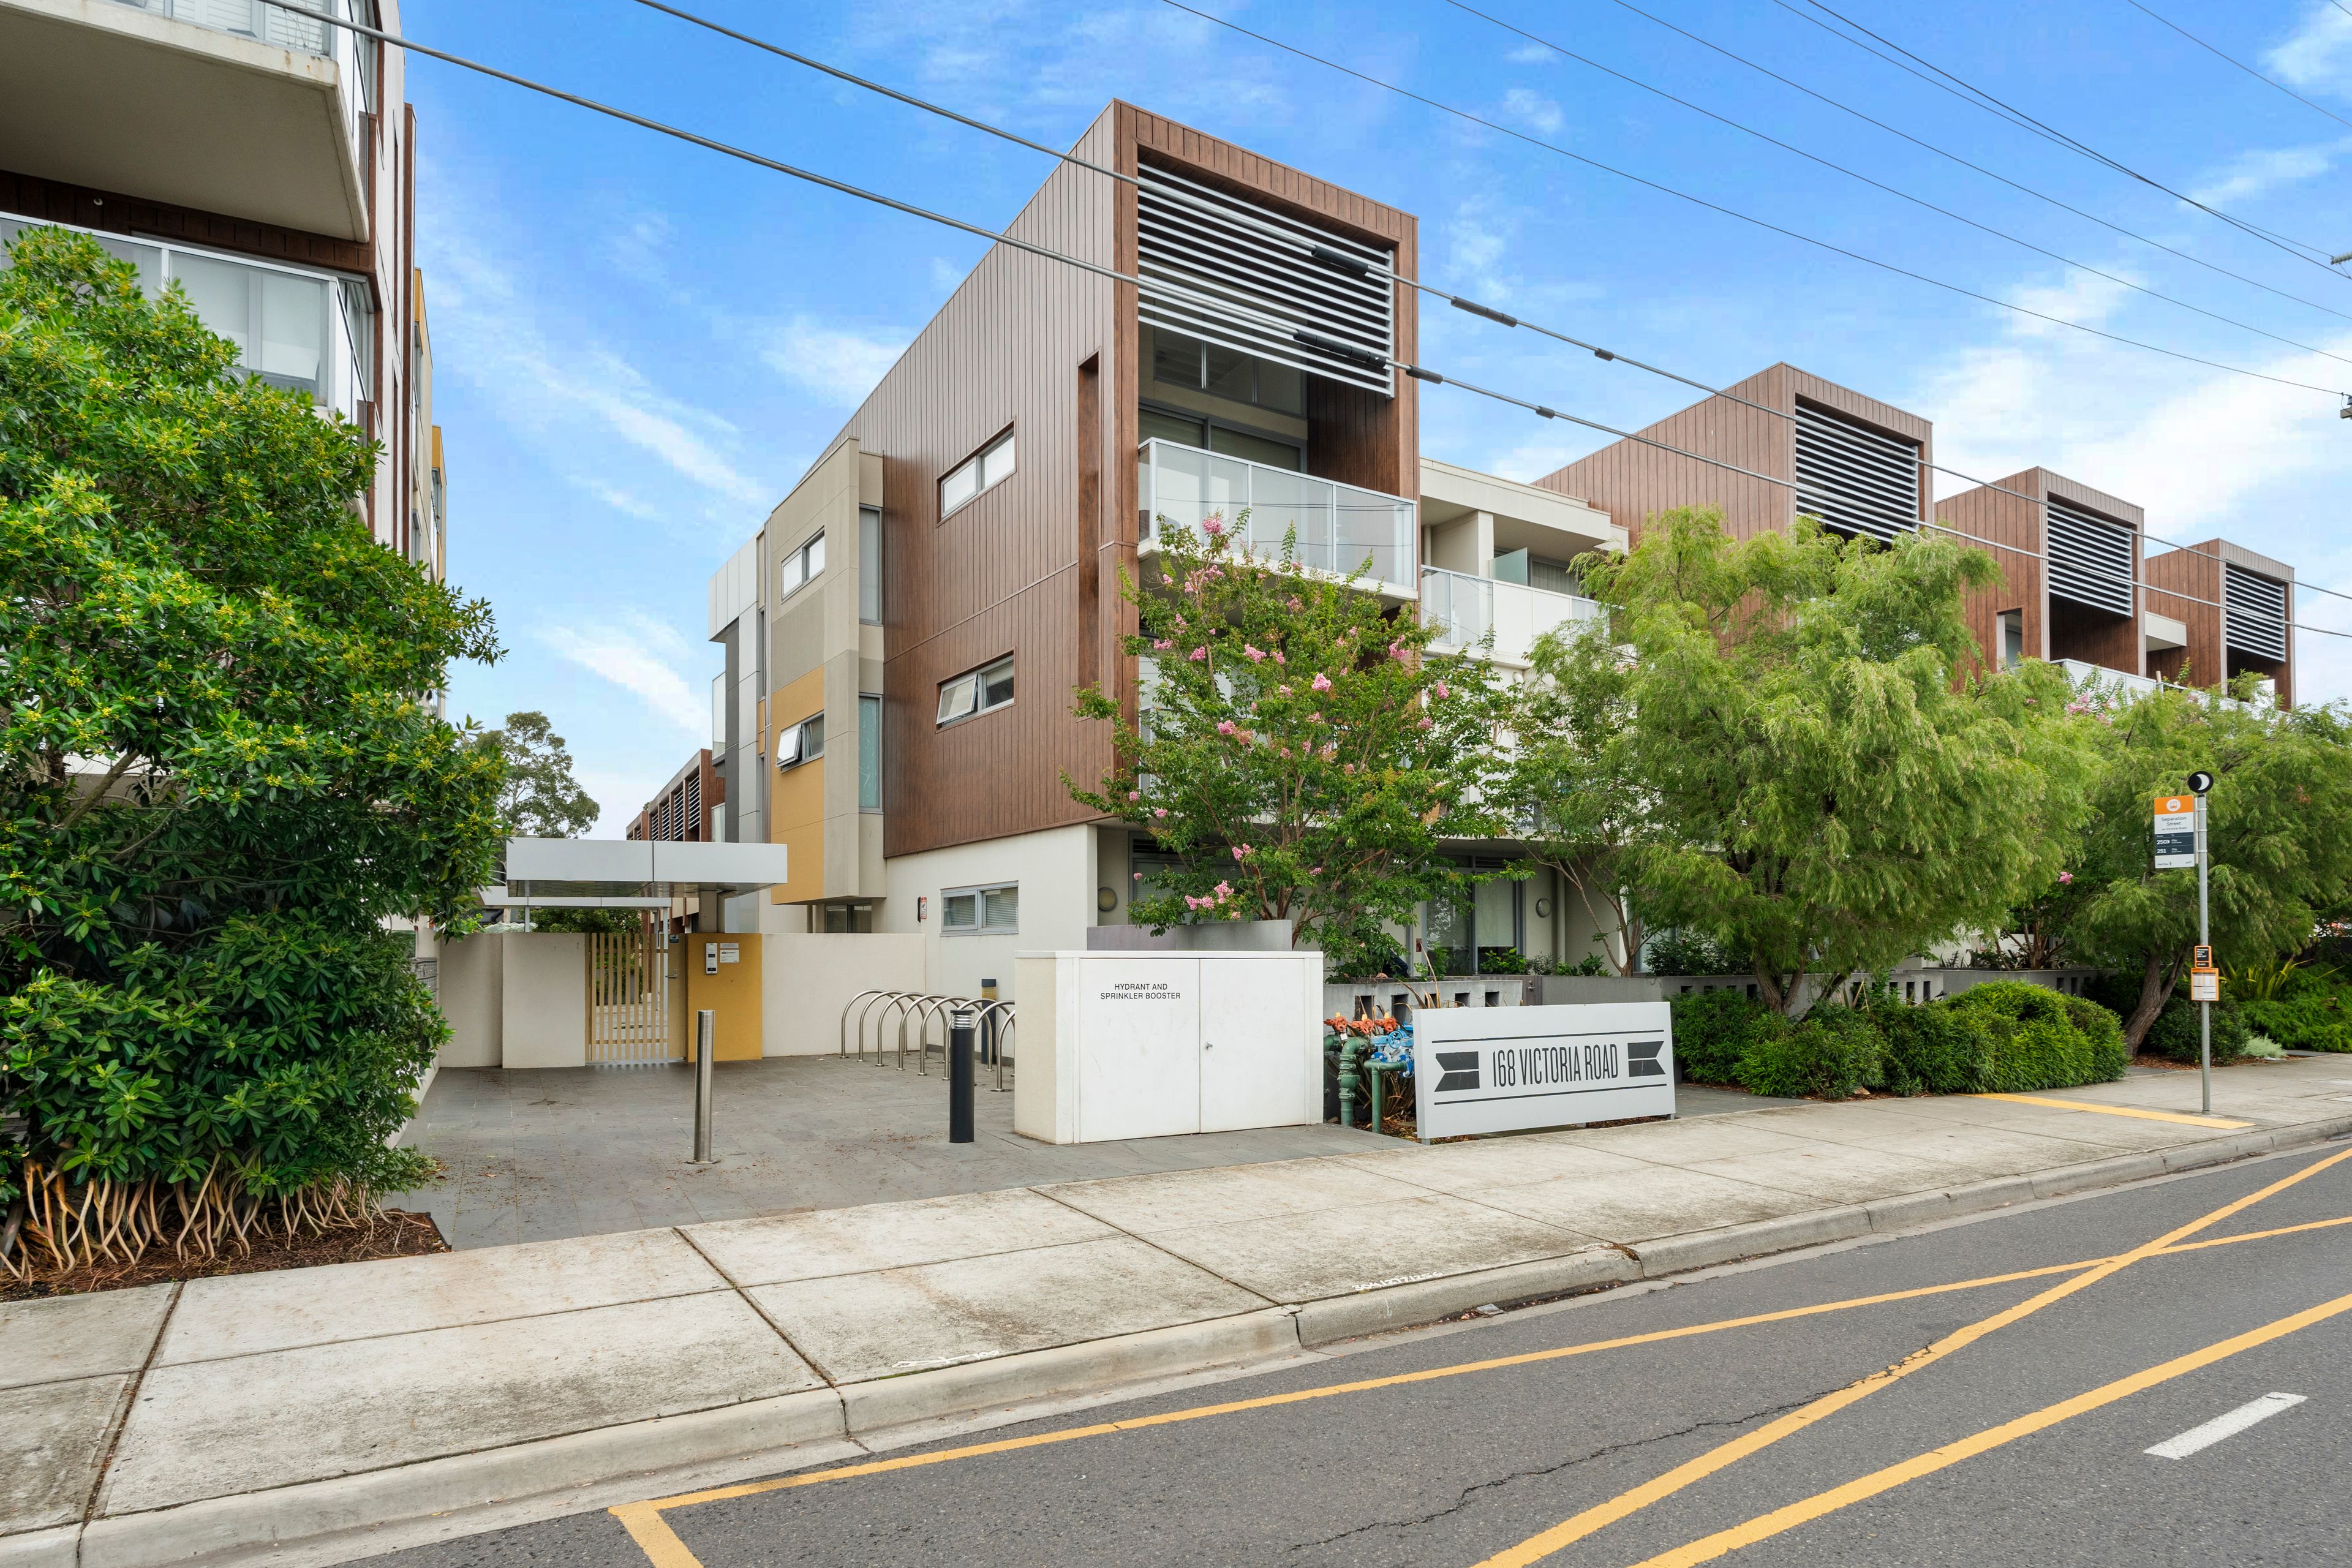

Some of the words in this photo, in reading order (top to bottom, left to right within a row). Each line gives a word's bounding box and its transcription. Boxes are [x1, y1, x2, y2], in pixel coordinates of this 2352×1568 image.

[1493, 1049, 1516, 1087] 168
[1519, 1046, 1581, 1085] VICTORIA
[1585, 1044, 1618, 1080] ROAD
